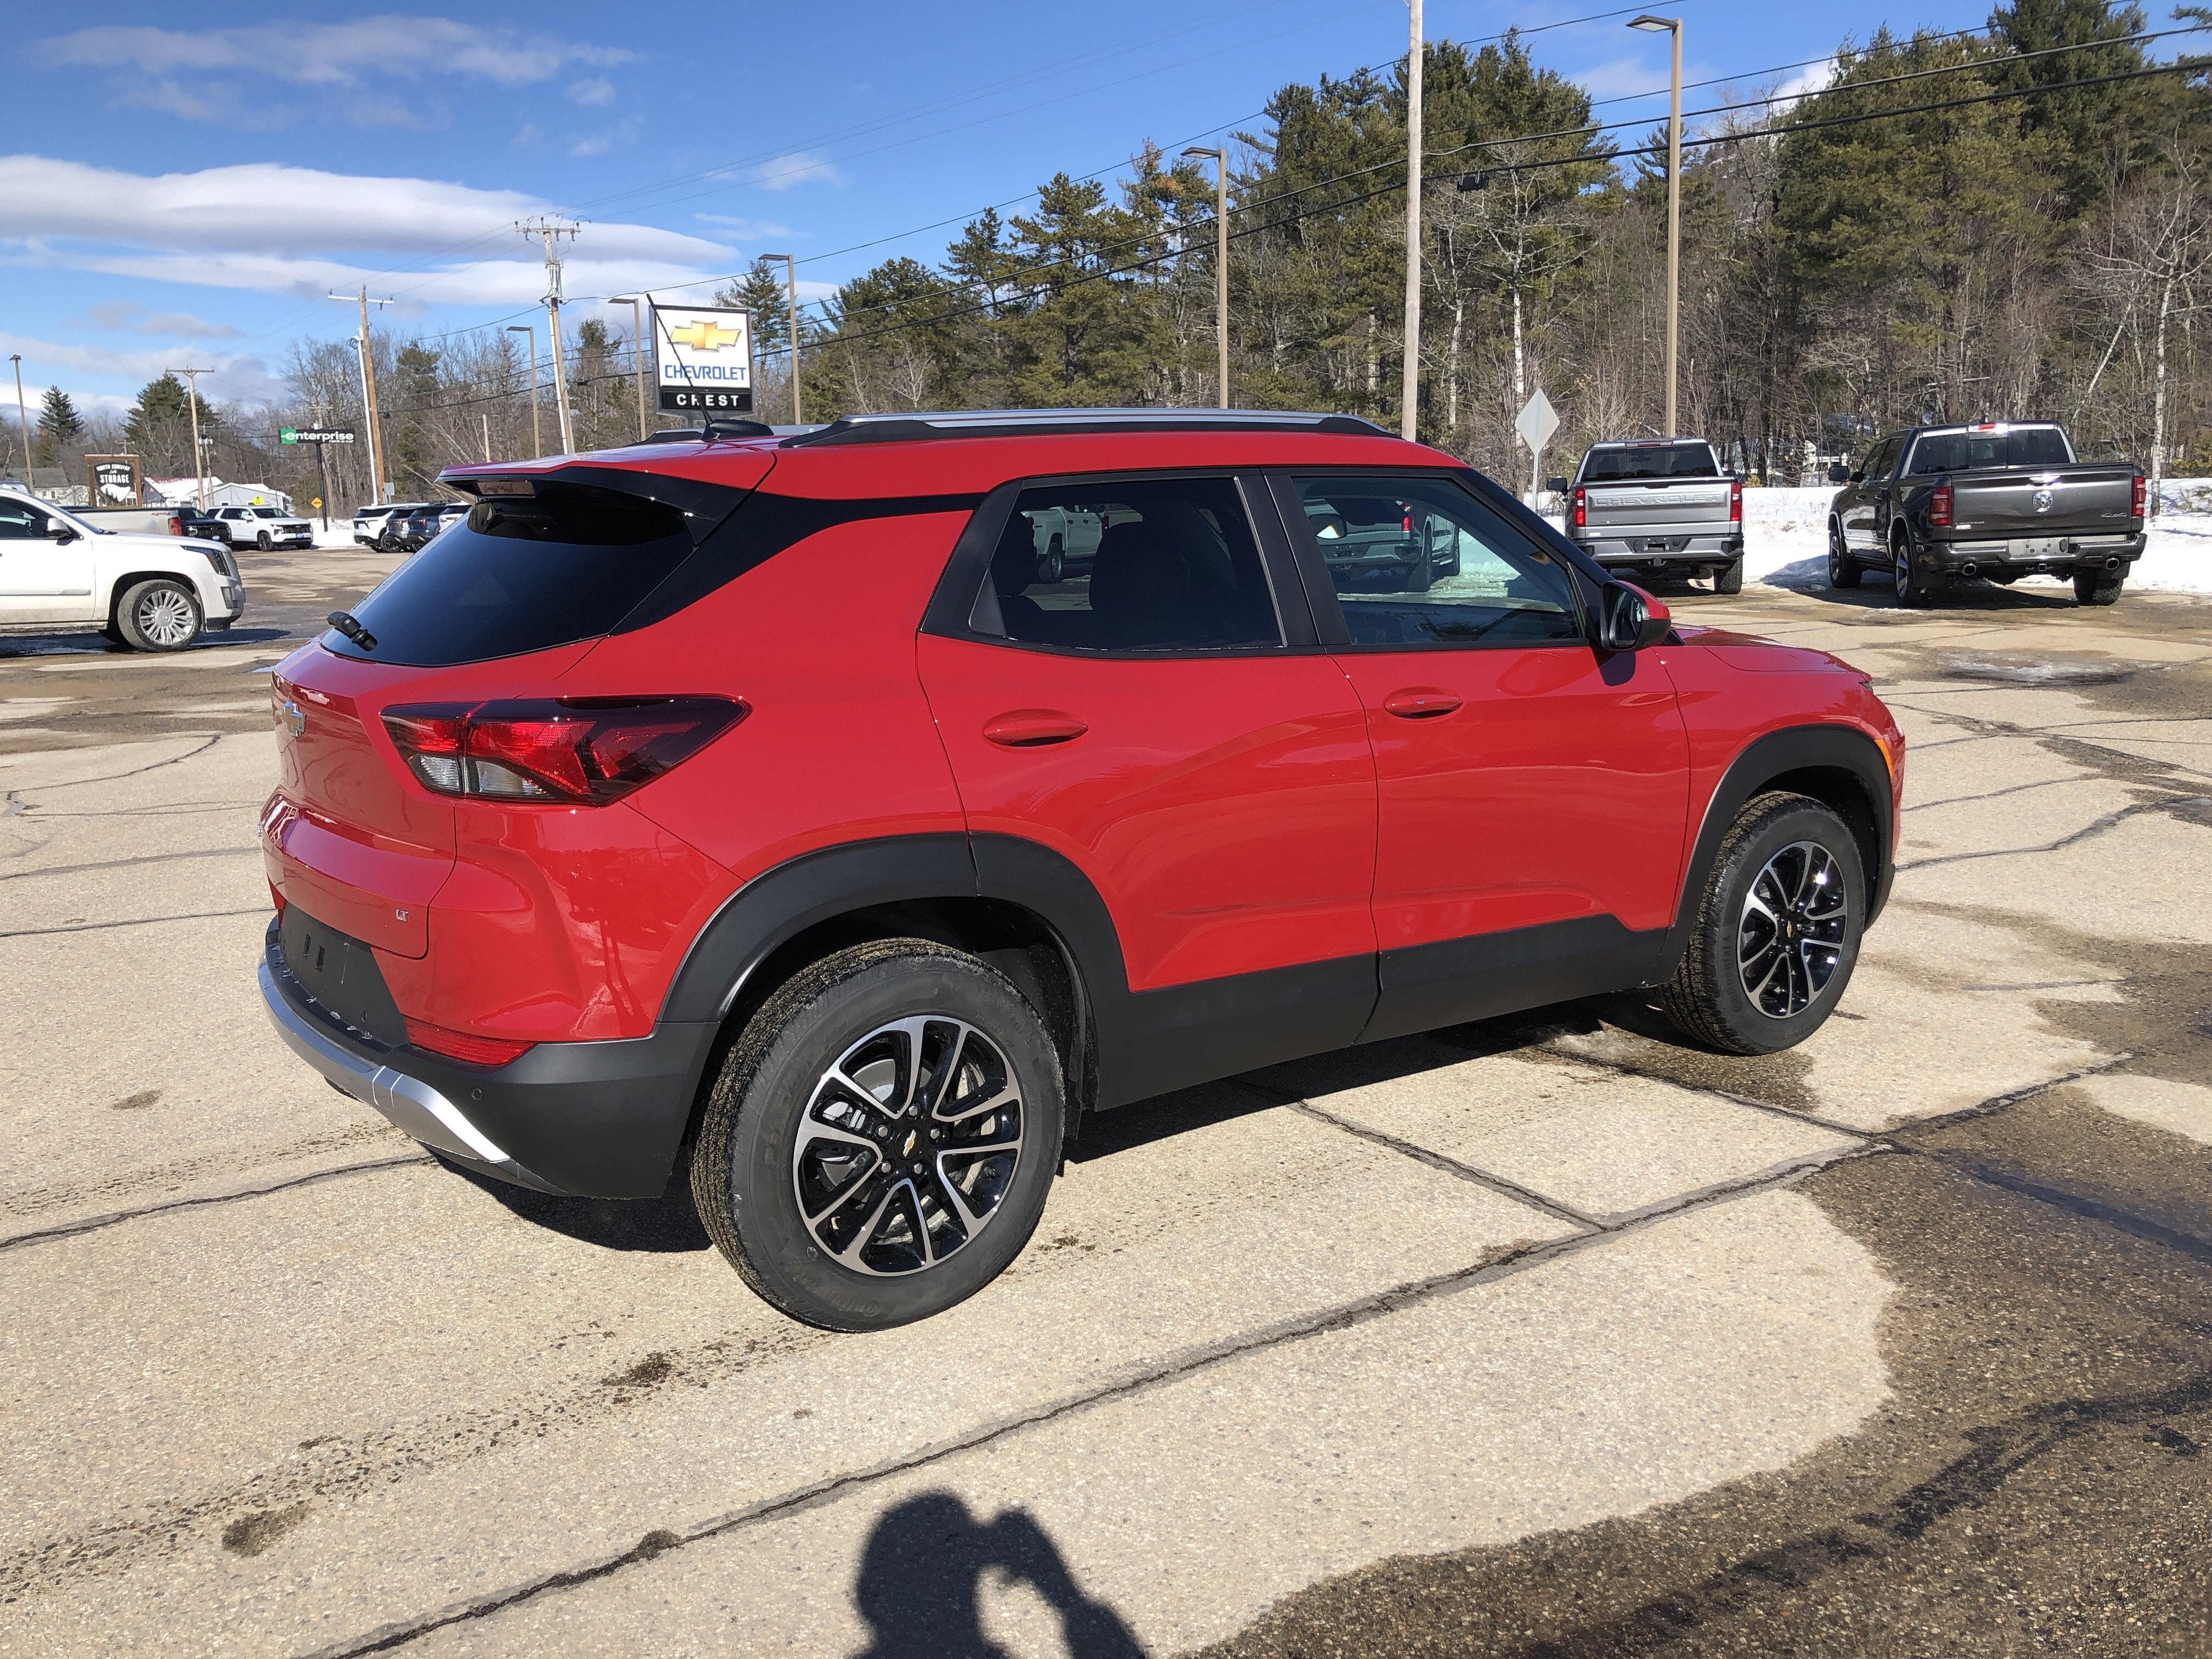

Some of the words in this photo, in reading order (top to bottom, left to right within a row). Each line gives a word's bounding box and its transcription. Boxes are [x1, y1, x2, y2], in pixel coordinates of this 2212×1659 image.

[664, 365, 747, 380] CHEVROLET
[285, 431, 354, 442] enterprise
[99, 474, 130, 483] STORAGE
[1594, 494, 1721, 506] CHEVROLET
[395, 909, 409, 922] LT
